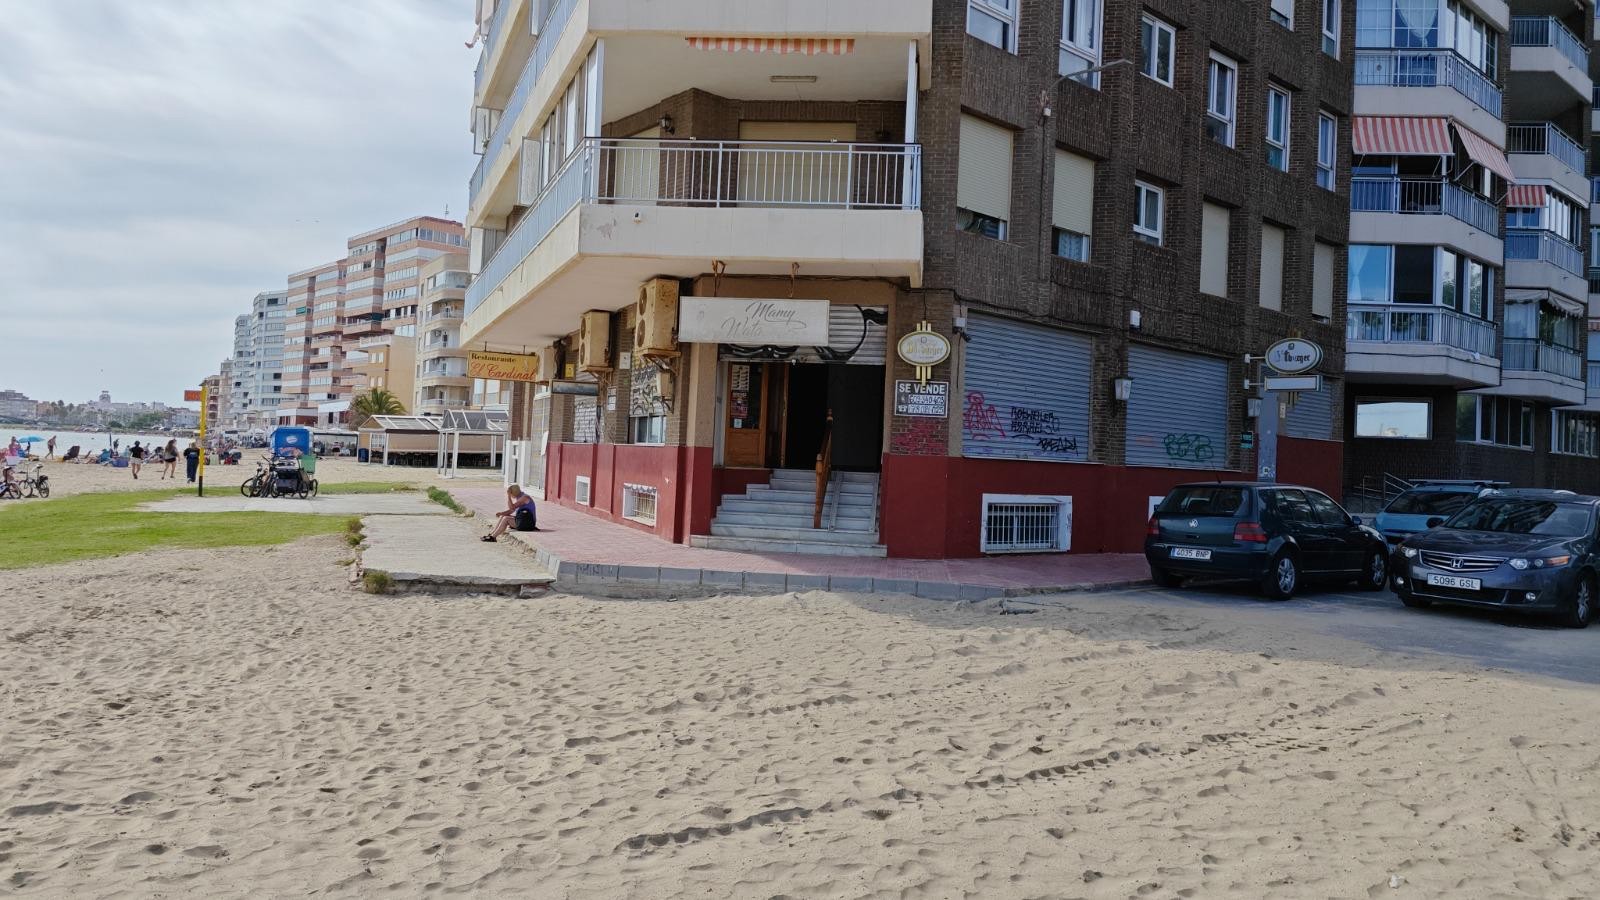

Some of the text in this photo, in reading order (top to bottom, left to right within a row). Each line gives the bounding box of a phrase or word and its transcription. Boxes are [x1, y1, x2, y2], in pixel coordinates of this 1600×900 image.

[745, 301, 807, 330] Mamy
[471, 352, 517, 363] Restaurante
[470, 360, 537, 380] El Cardinal
[899, 383, 946, 395] SE VENDE
[1433, 575, 1477, 589] 5096 GSL
